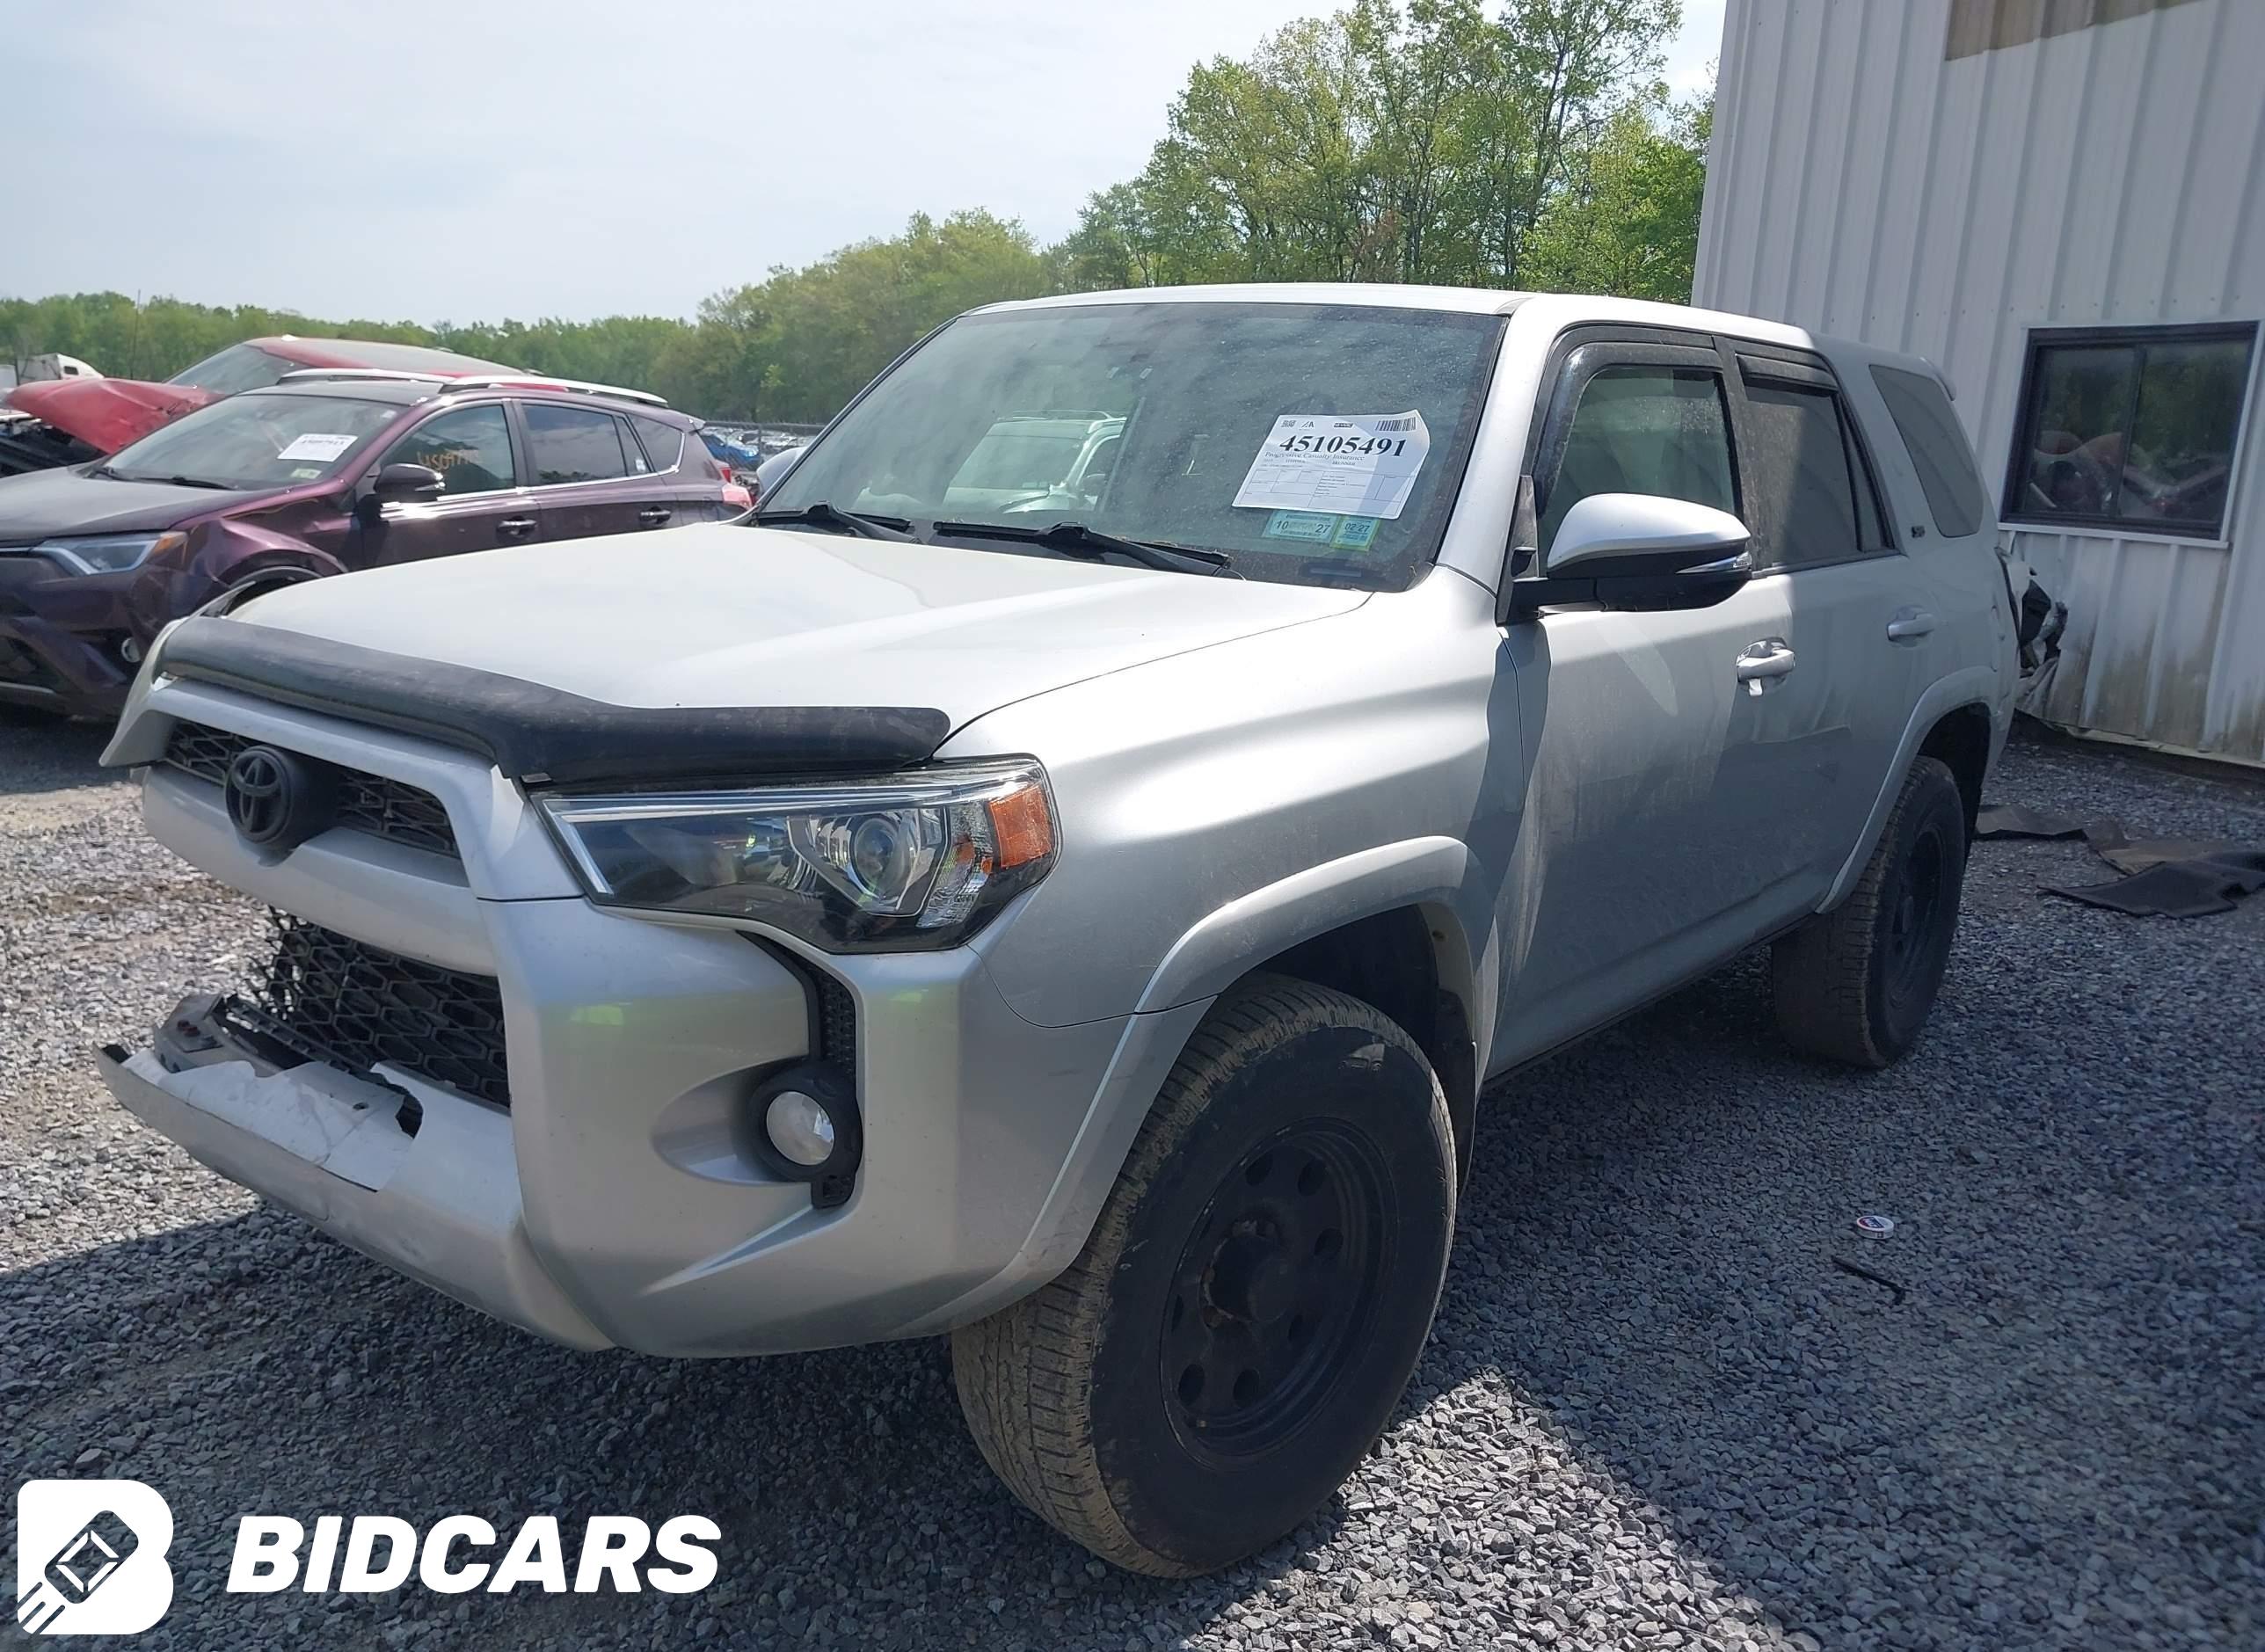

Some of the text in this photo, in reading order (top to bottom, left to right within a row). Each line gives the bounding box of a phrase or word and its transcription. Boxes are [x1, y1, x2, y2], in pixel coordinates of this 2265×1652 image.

[1279, 435, 1407, 456] 45105491
[1303, 452, 1330, 461] Casualty
[1276, 520, 1289, 530] 10
[1315, 523, 1331, 534] 27
